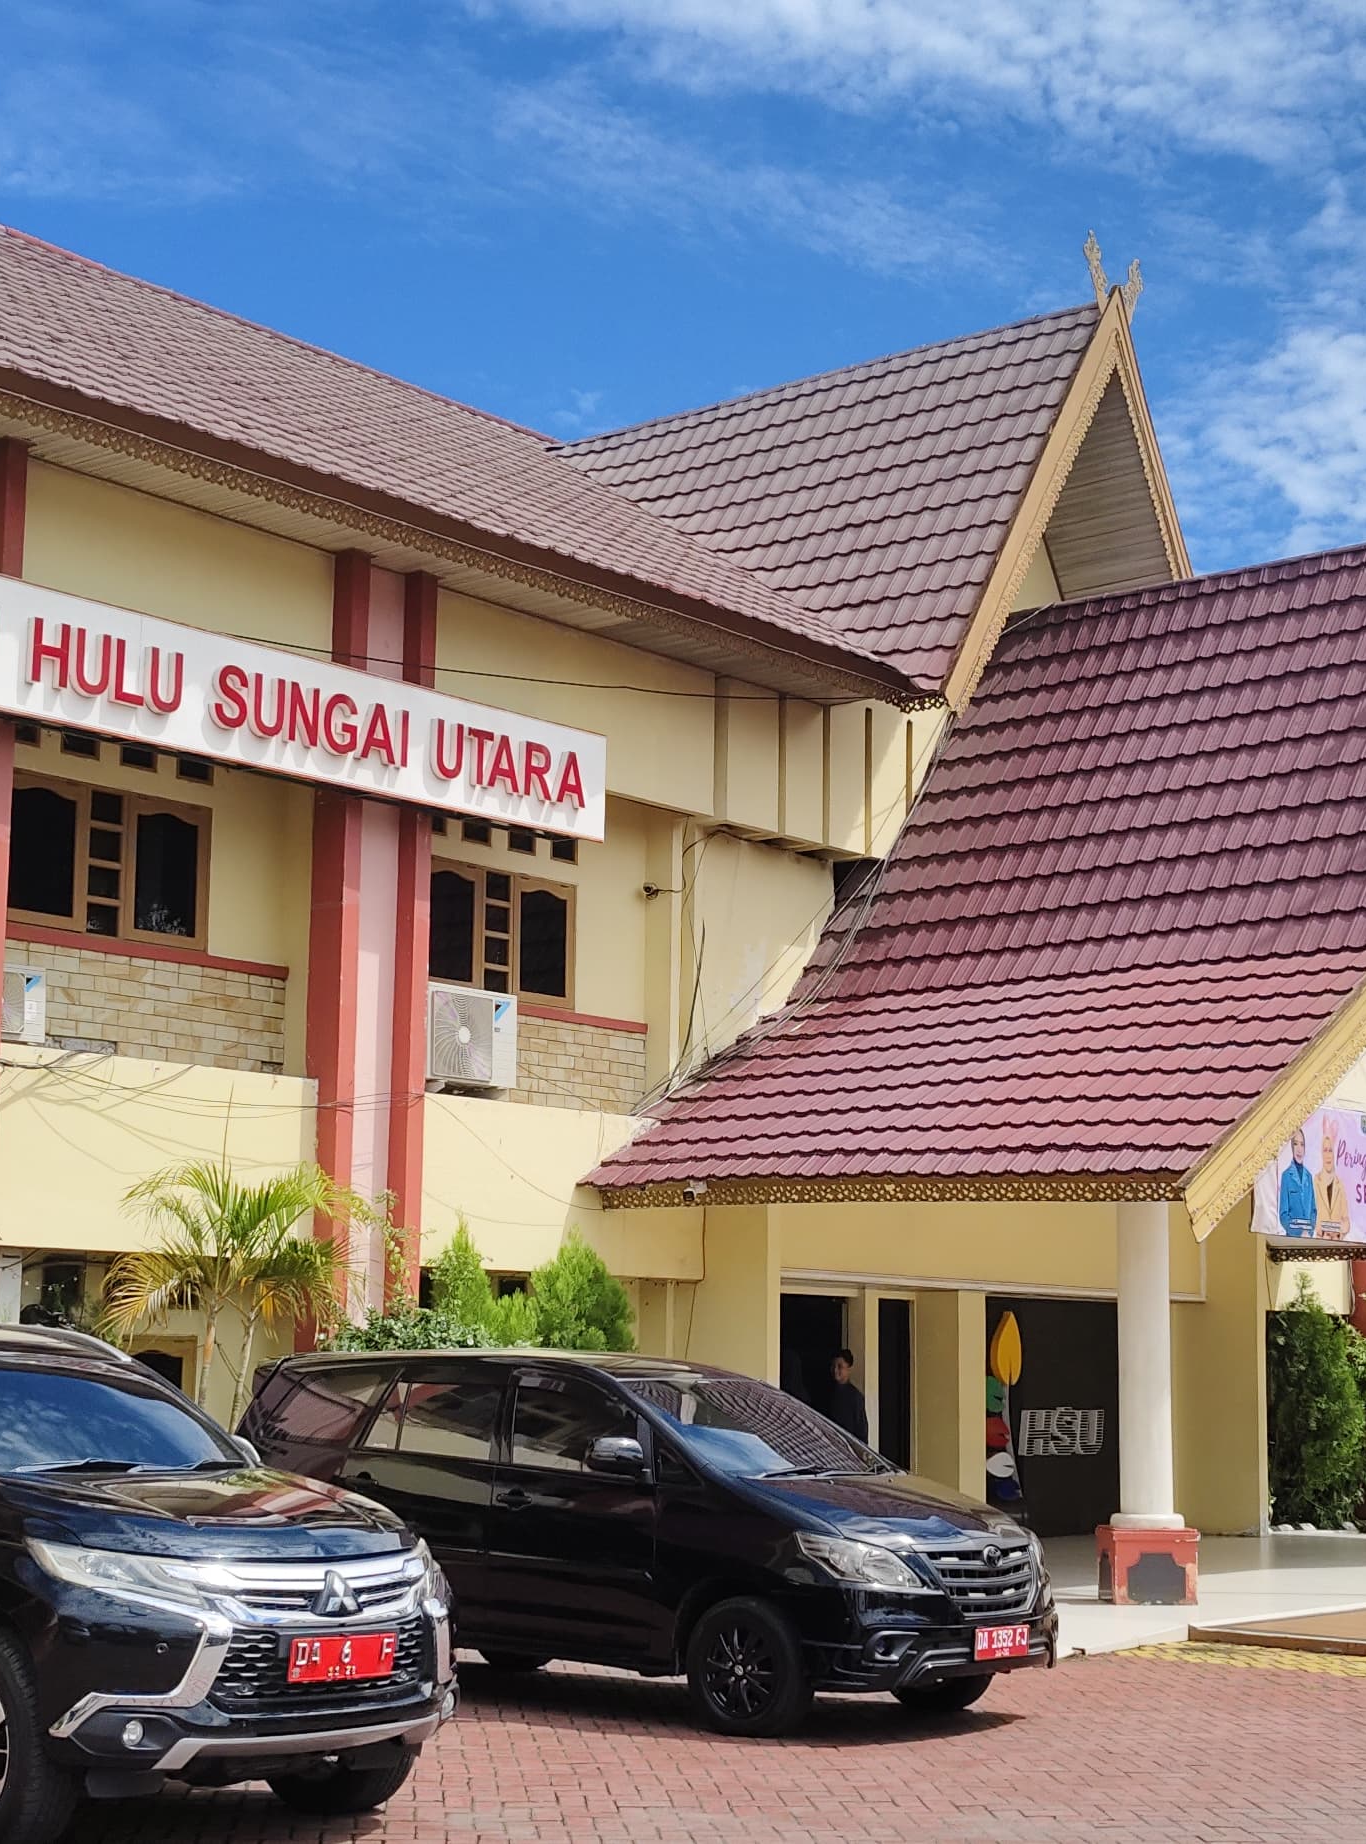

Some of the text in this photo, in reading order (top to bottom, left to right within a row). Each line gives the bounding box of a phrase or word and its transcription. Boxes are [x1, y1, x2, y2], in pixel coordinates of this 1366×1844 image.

[27, 617, 184, 715] HULU
[209, 665, 410, 768] SUNGAI
[431, 717, 585, 809] UTARA
[1018, 1406, 1105, 1456] HSU
[295, 1641, 321, 1666] DA
[341, 1639, 352, 1664] 6
[977, 1627, 1028, 1650] DA 1352 FJ
